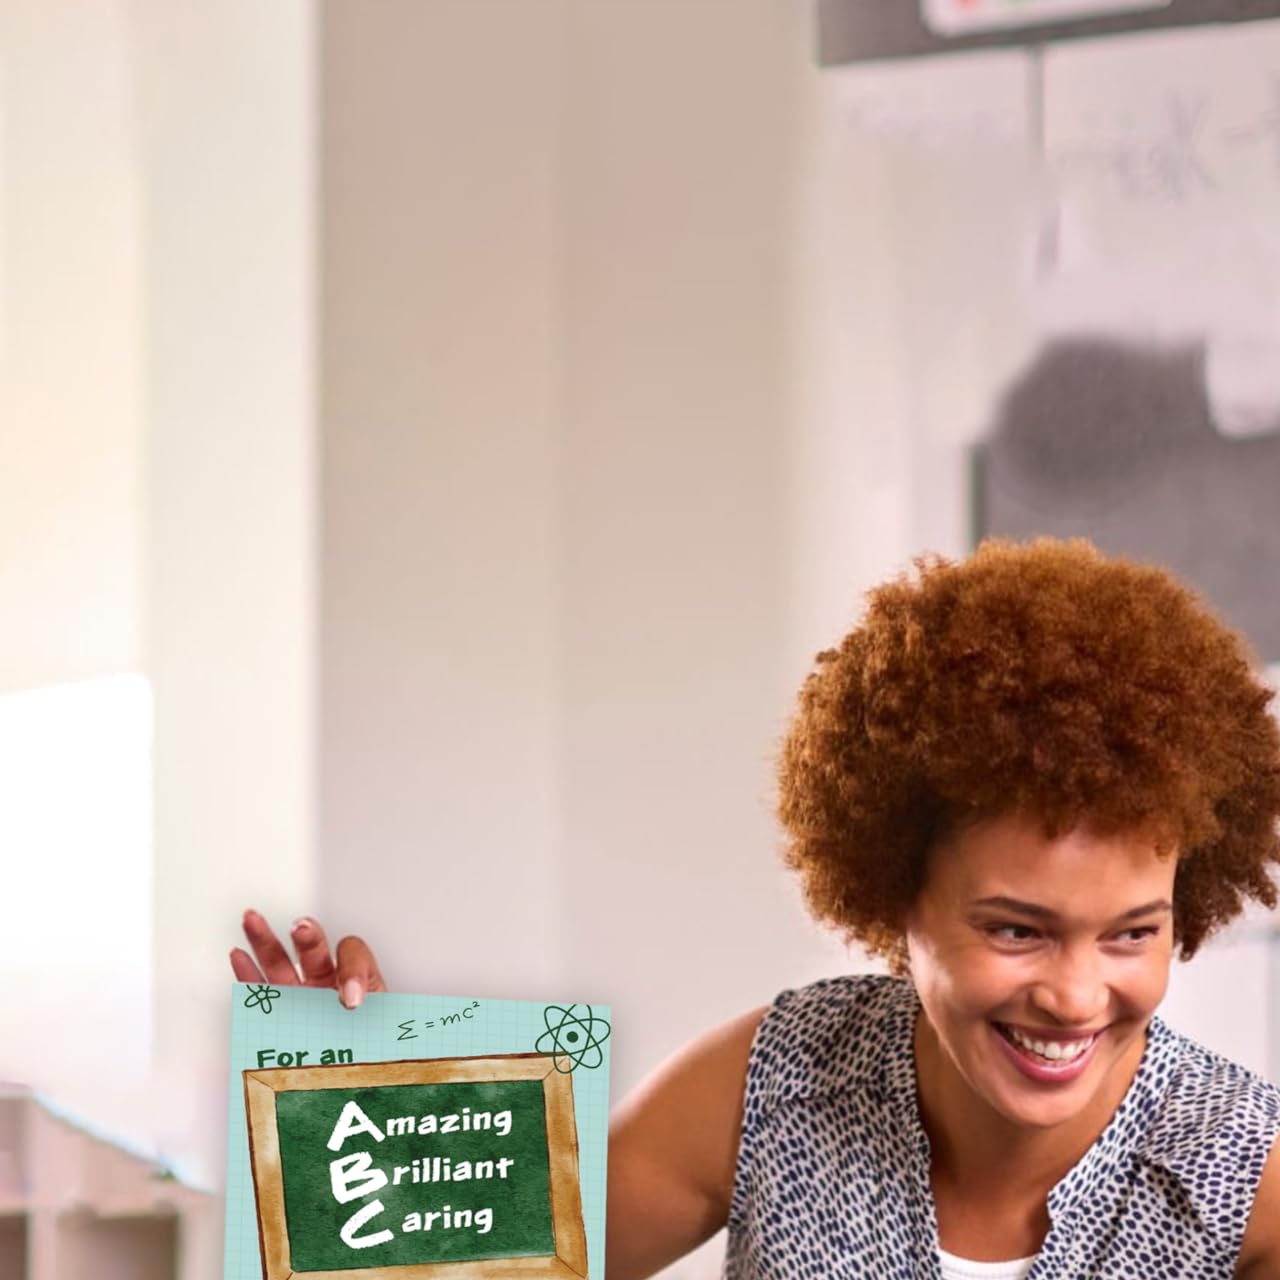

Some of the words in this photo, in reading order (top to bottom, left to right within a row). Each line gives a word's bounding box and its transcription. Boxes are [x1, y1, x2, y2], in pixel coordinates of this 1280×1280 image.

[257, 1049, 309, 1067] For
[320, 1049, 353, 1065] an
[327, 1101, 512, 1151] Amazing
[330, 1152, 514, 1204] Brilliant
[340, 1200, 493, 1249] Caring
